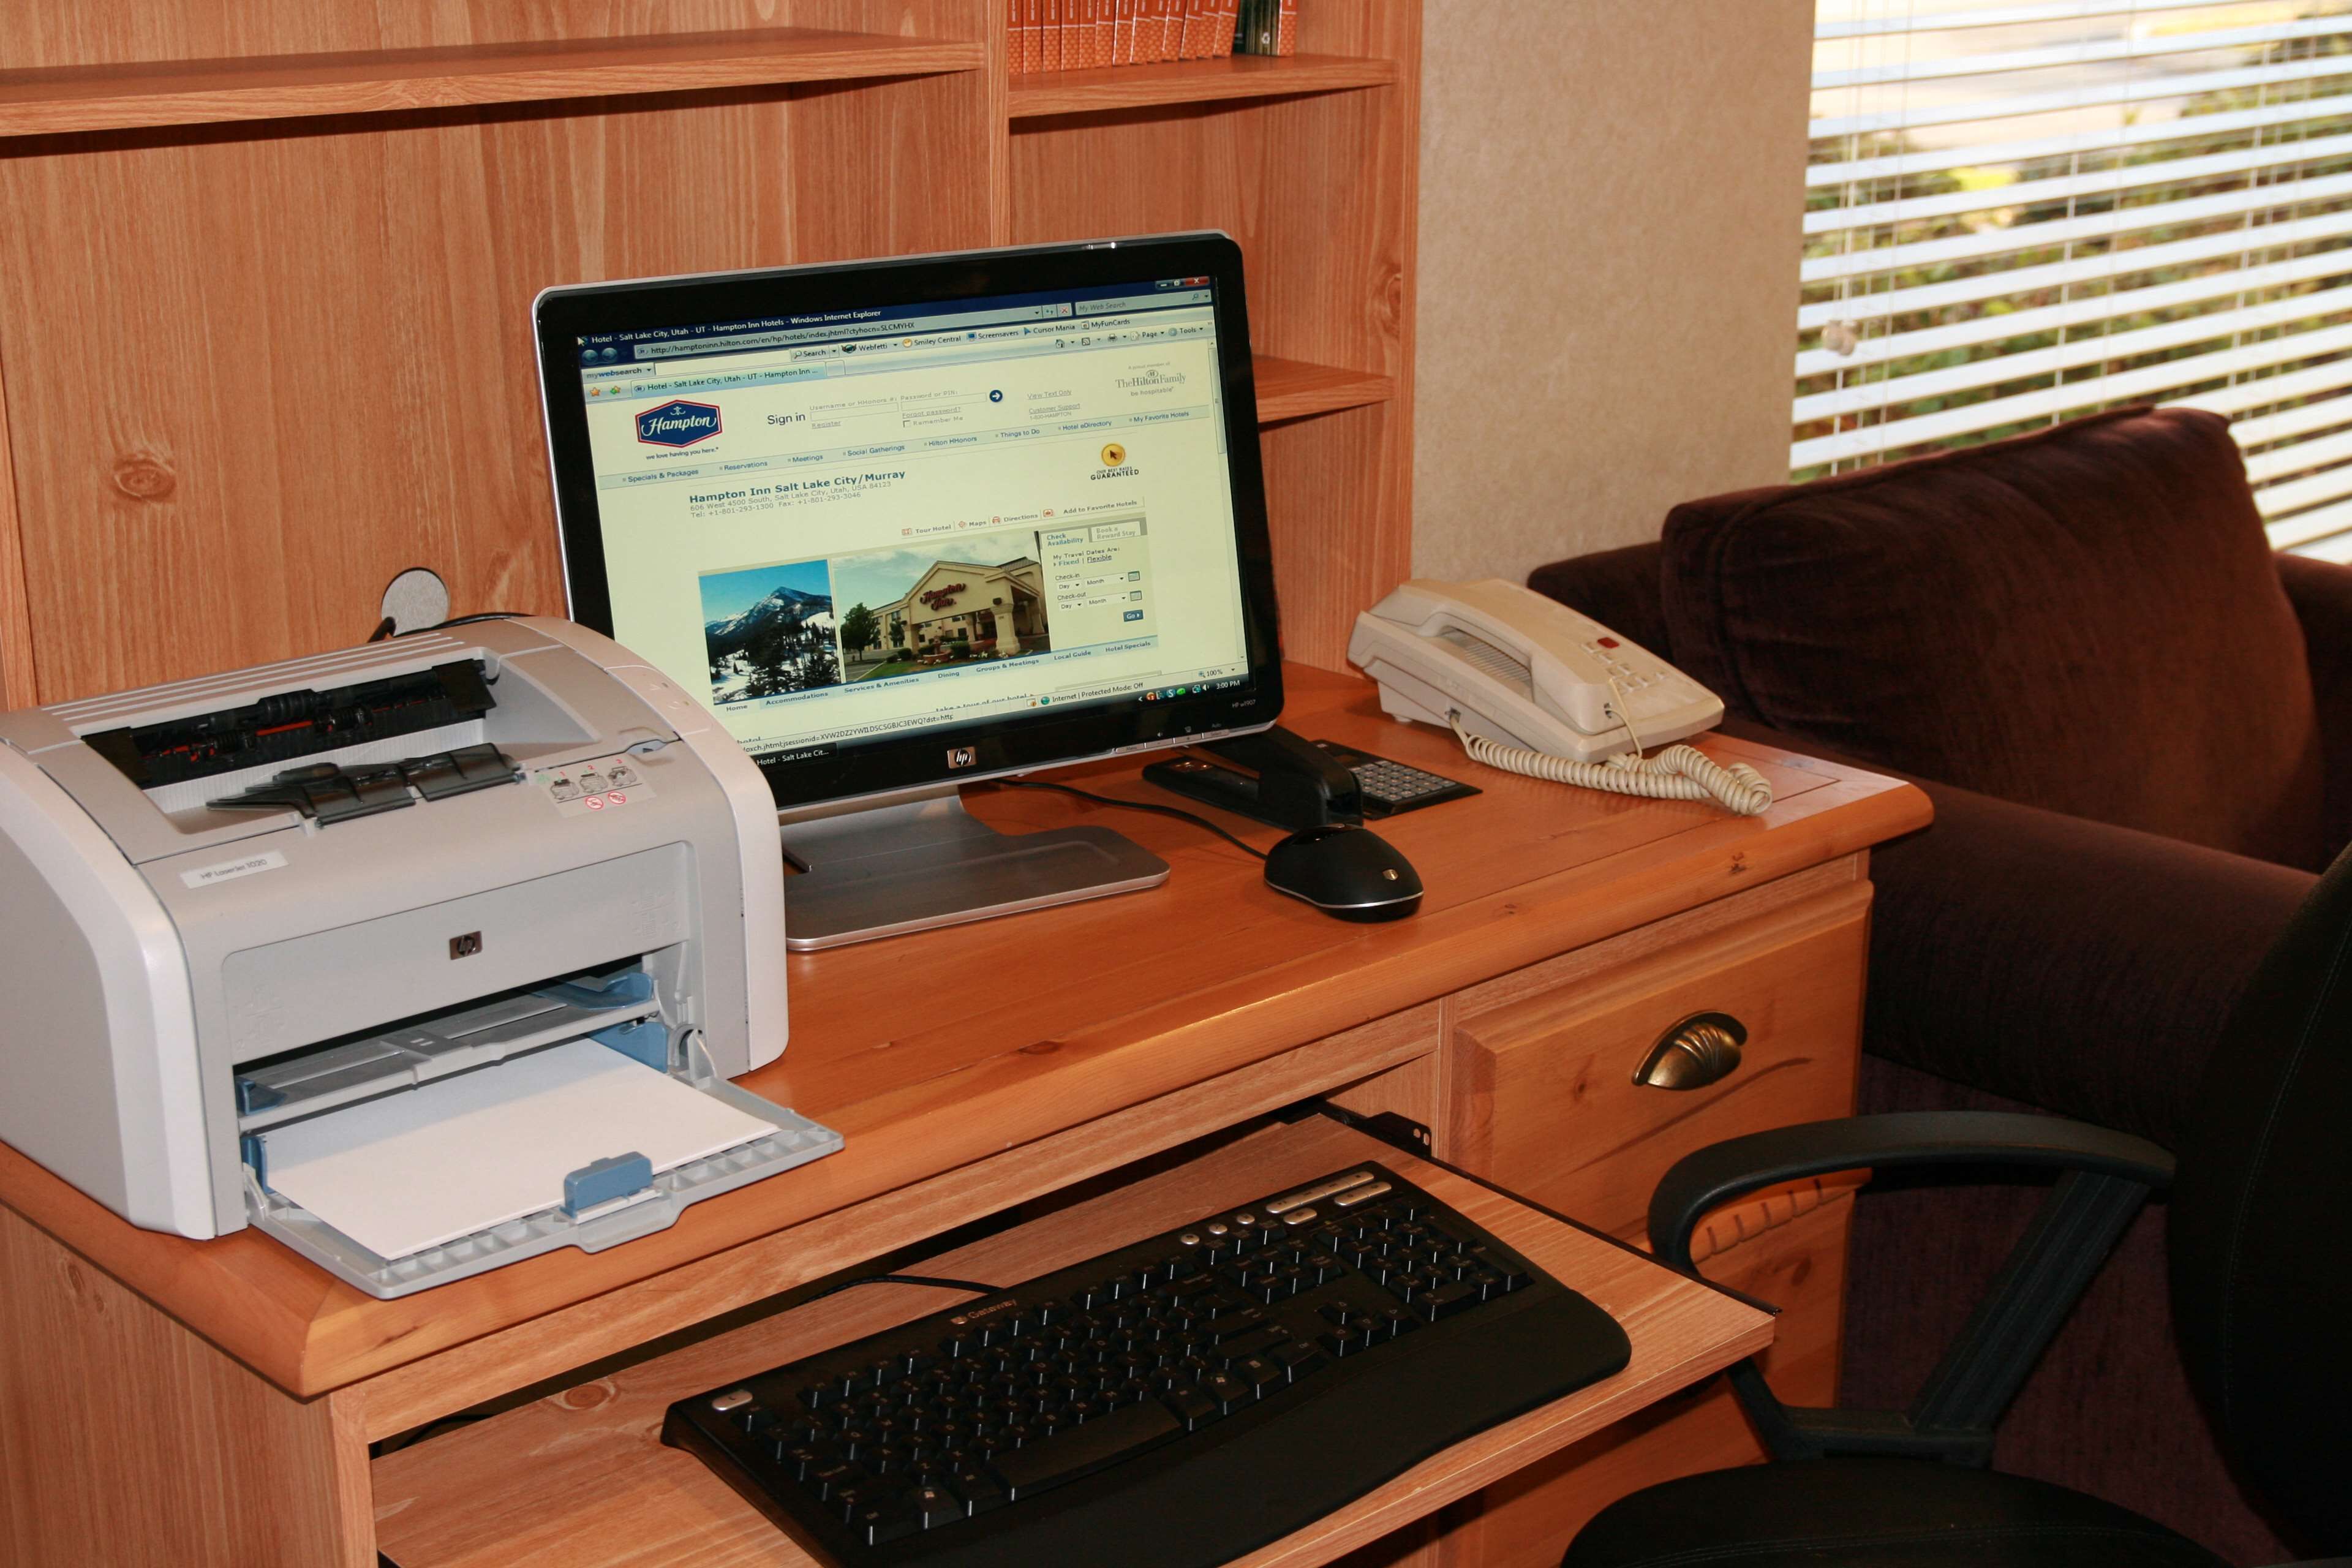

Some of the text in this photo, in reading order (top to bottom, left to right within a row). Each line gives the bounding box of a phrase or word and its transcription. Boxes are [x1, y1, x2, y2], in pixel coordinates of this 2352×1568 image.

[1104, 301, 1126, 309] Search
[712, 323, 747, 333] Hampton
[853, 311, 882, 319] Explorer
[859, 343, 888, 352] Webfetti
[914, 337, 936, 346] Smiley
[938, 335, 961, 344] Central
[978, 330, 1019, 339] Screensavers
[1091, 318, 1130, 328] MyFunCards
[587, 368, 642, 379] mywebsearch
[648, 382, 668, 390] Hotel
[688, 378, 704, 386] Lake
[765, 369, 797, 379] Hampton
[641, 415, 717, 436] Hampton
[767, 412, 805, 426] Sign in
[628, 474, 657, 483] Specials
[667, 470, 699, 479] Packages
[724, 461, 767, 470] Reservations
[793, 454, 824, 464] Meetings
[869, 445, 905, 454] Gatherings
[949, 435, 978, 444] HHonors
[1000, 431, 1022, 439] Things
[1080, 420, 1112, 429] eDirectory
[669, 450, 689, 459] having
[1090, 469, 1139, 480] GUARANTEED
[690, 490, 746, 503] Hampton
[775, 483, 799, 492] Salt
[803, 480, 831, 489] Lake
[834, 471, 905, 486] City/Murray
[791, 490, 809, 499] Lake
[1004, 513, 1038, 522] Directions
[1087, 503, 1115, 511] Favorite
[1047, 537, 1083, 547] Availability
[1087, 554, 1112, 564] Flexible
[1055, 573, 1080, 581] Check-in
[1057, 592, 1086, 601] Check-out
[766, 692, 829, 706] Accommodations
[845, 684, 875, 693] Services
[884, 677, 919, 687] Amenities
[1009, 658, 1039, 668] Meetings
[1125, 641, 1151, 650] Specials
[1052, 693, 1076, 702] Internet
[1081, 687, 1111, 698] Protected
[756, 756, 776, 766] Hotel
[782, 753, 795, 762] Salt
[214, 865, 246, 876] LaserJet
[246, 858, 268, 869] 1020
